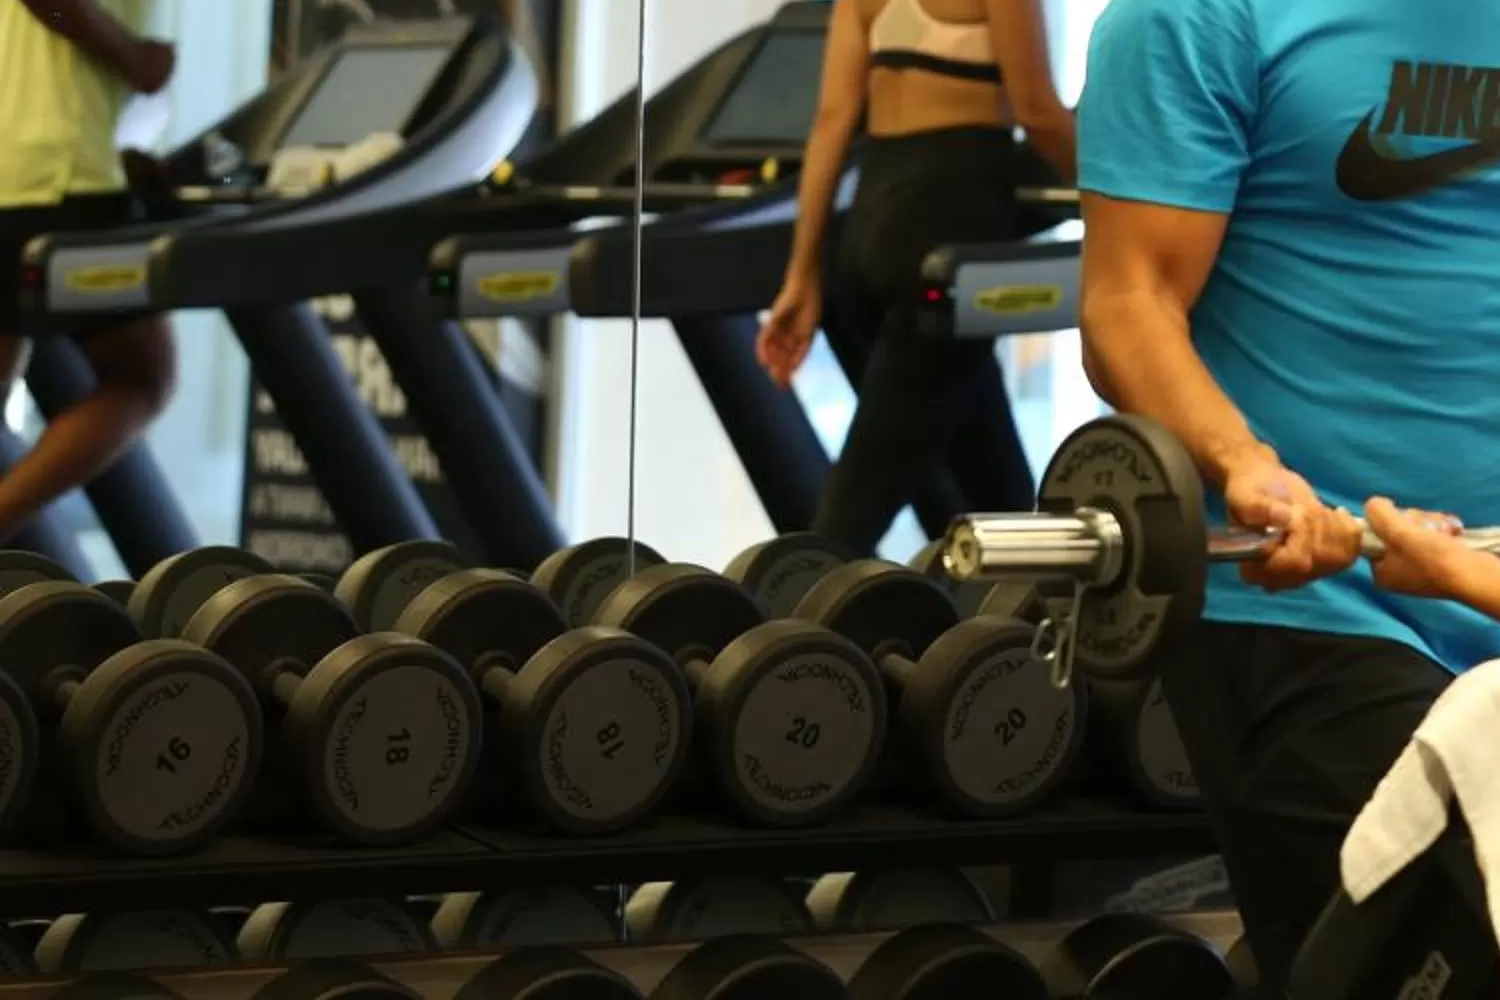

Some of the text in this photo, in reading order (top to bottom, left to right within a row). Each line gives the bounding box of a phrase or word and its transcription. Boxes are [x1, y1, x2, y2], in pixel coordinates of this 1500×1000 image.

[597, 721, 626, 761] 18
[785, 716, 821, 749] 20
[993, 706, 1028, 747] 20
[155, 735, 192, 774] 16
[385, 727, 411, 766] 18
